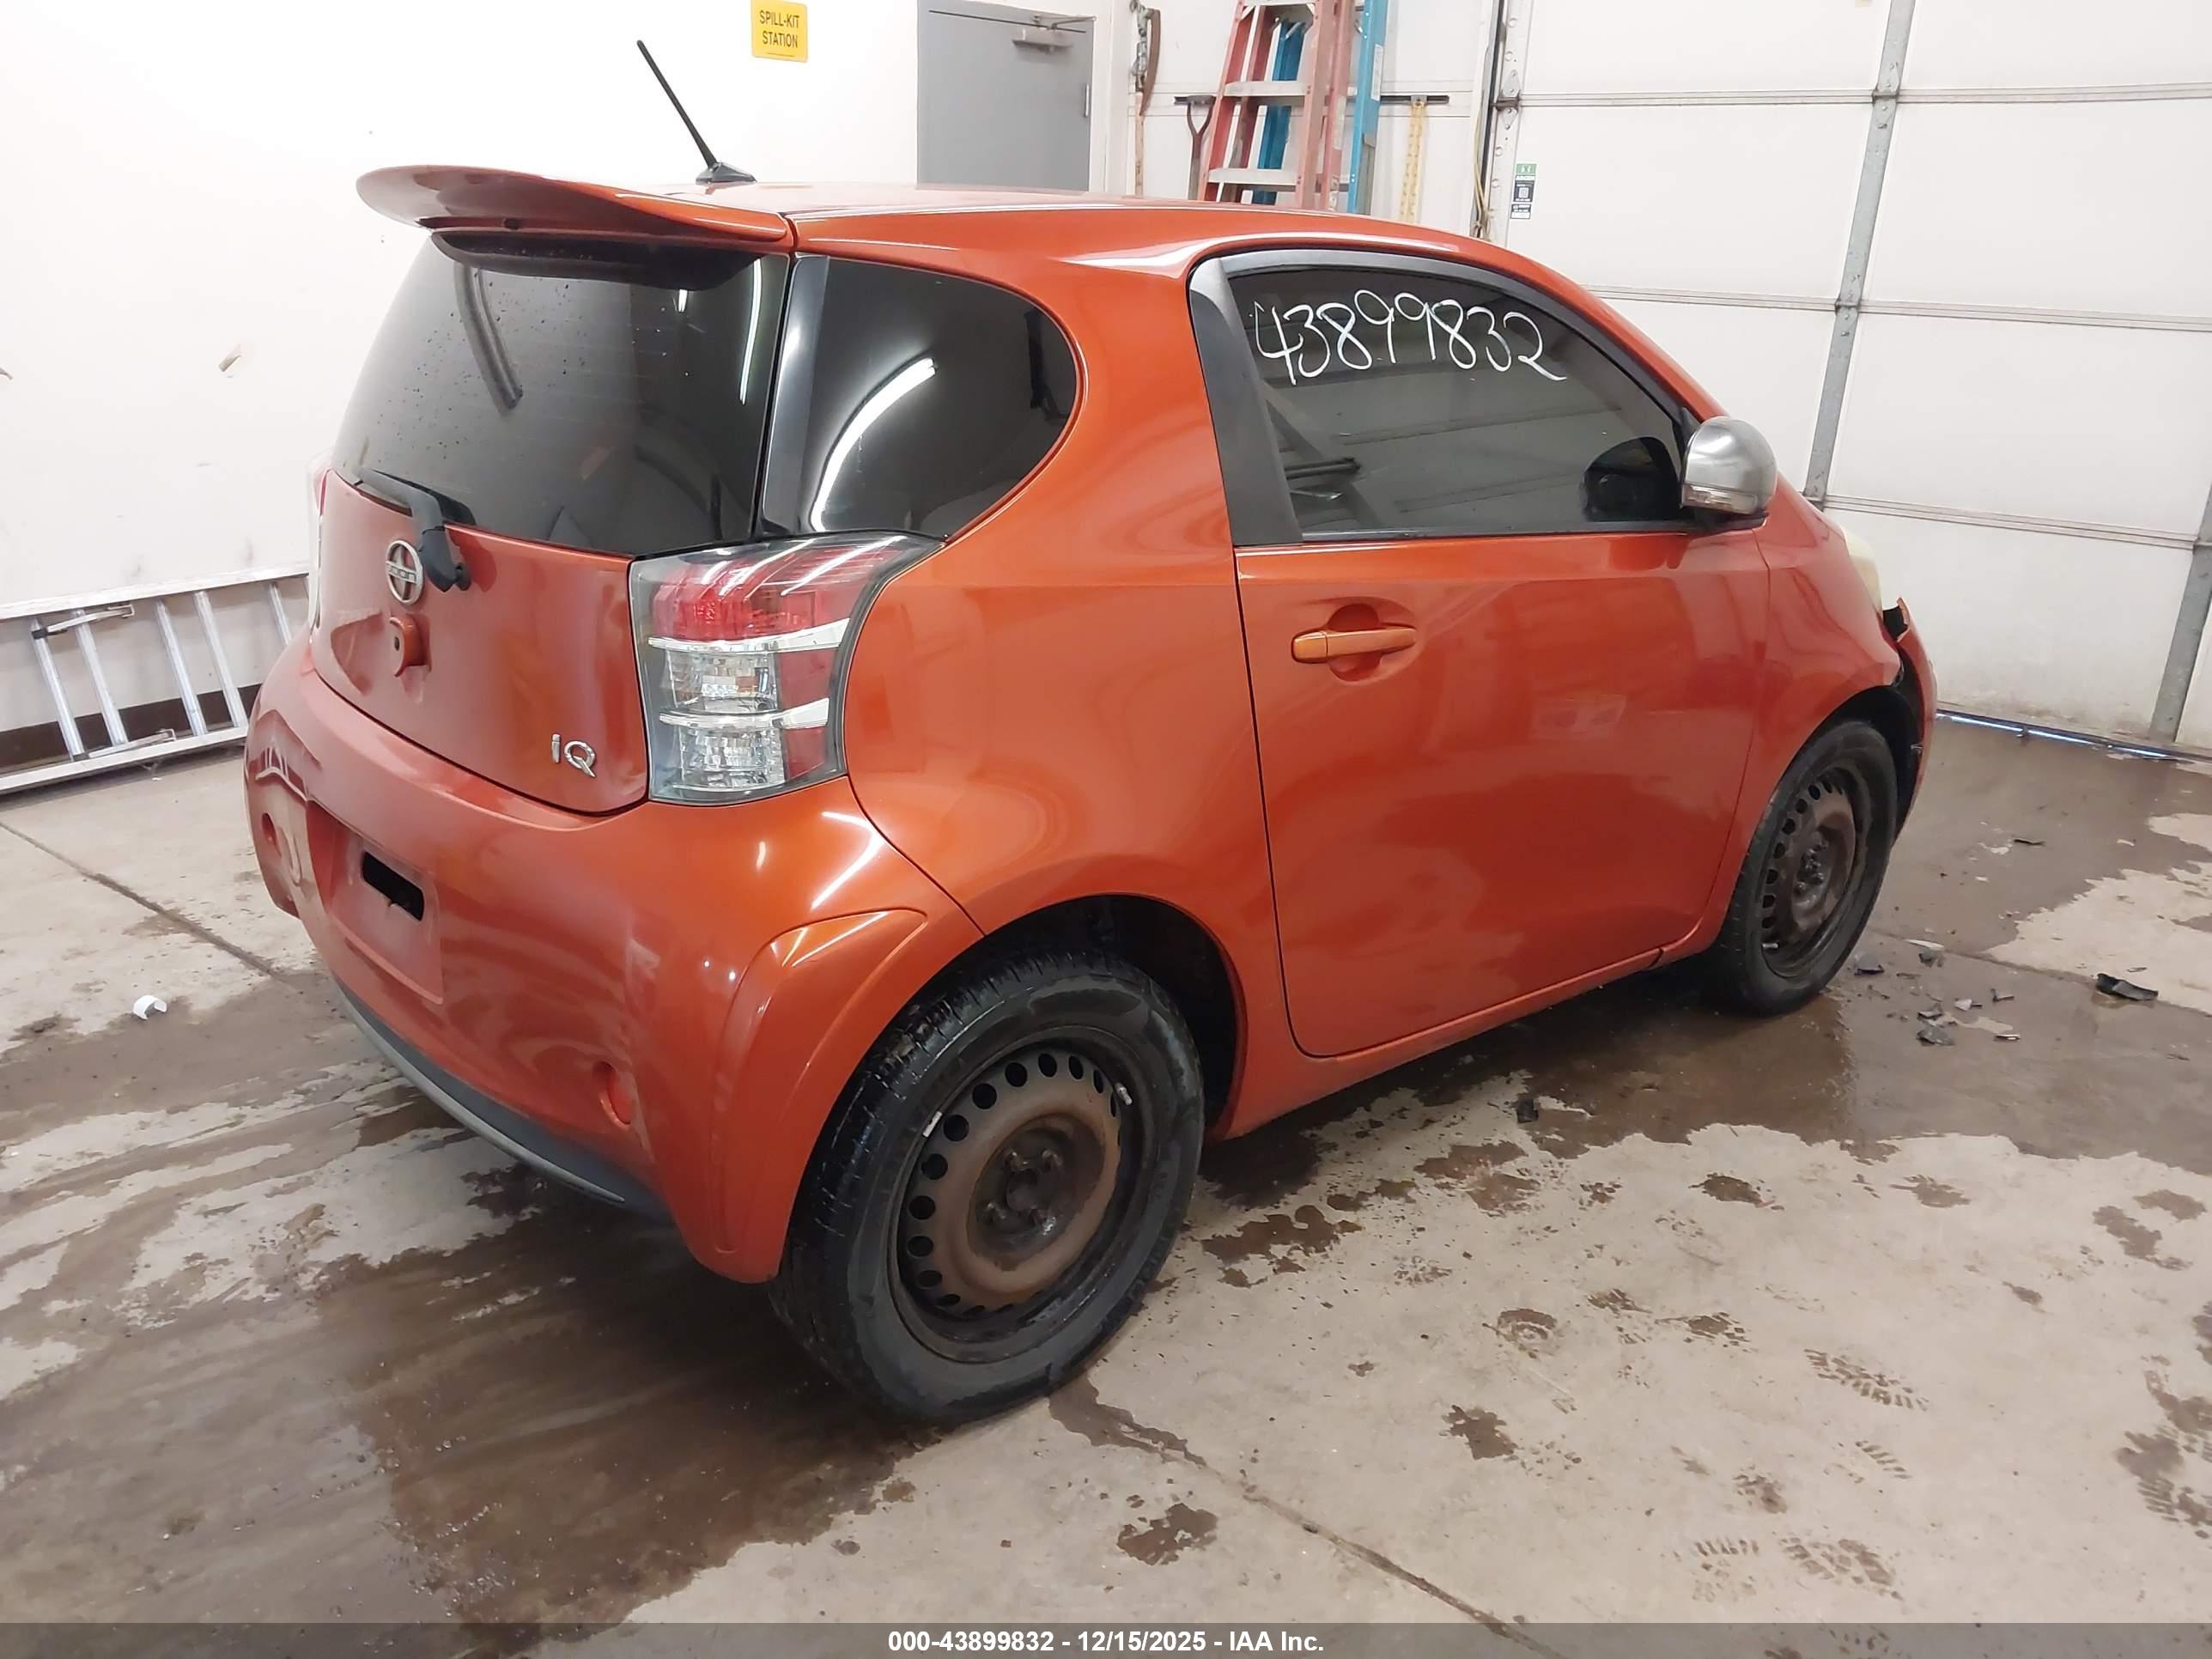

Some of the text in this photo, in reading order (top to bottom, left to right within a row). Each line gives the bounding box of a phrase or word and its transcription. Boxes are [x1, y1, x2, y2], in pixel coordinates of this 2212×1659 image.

[759, 9, 799, 28] SPILL-KIT
[762, 30, 798, 48] STATION
[1252, 289, 1566, 386] 43899832
